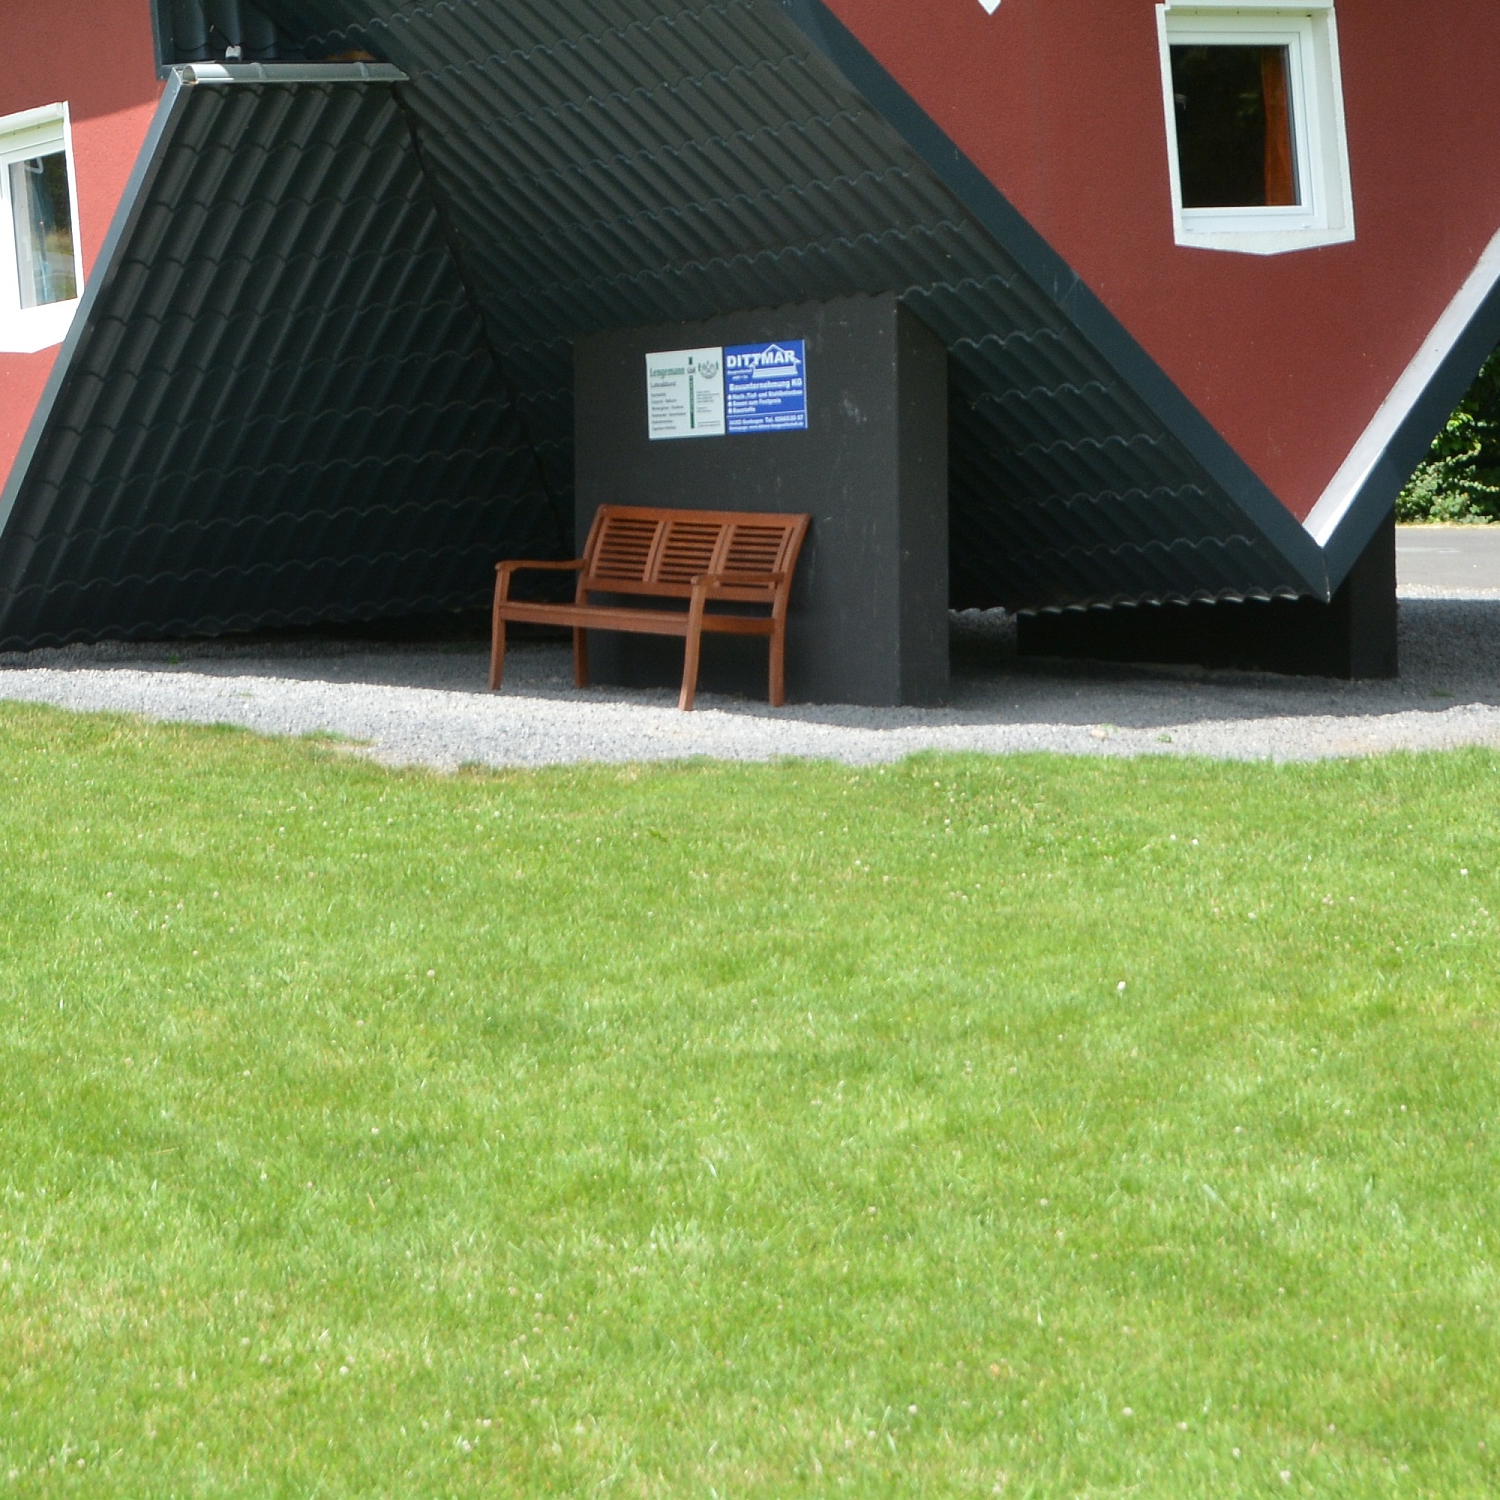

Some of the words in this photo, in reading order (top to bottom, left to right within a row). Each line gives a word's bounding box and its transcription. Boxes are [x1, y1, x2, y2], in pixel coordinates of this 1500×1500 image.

[727, 350, 795, 368] DITTMAR
[729, 381, 790, 391] Bauunternehmung
[791, 378, 802, 387] KG
